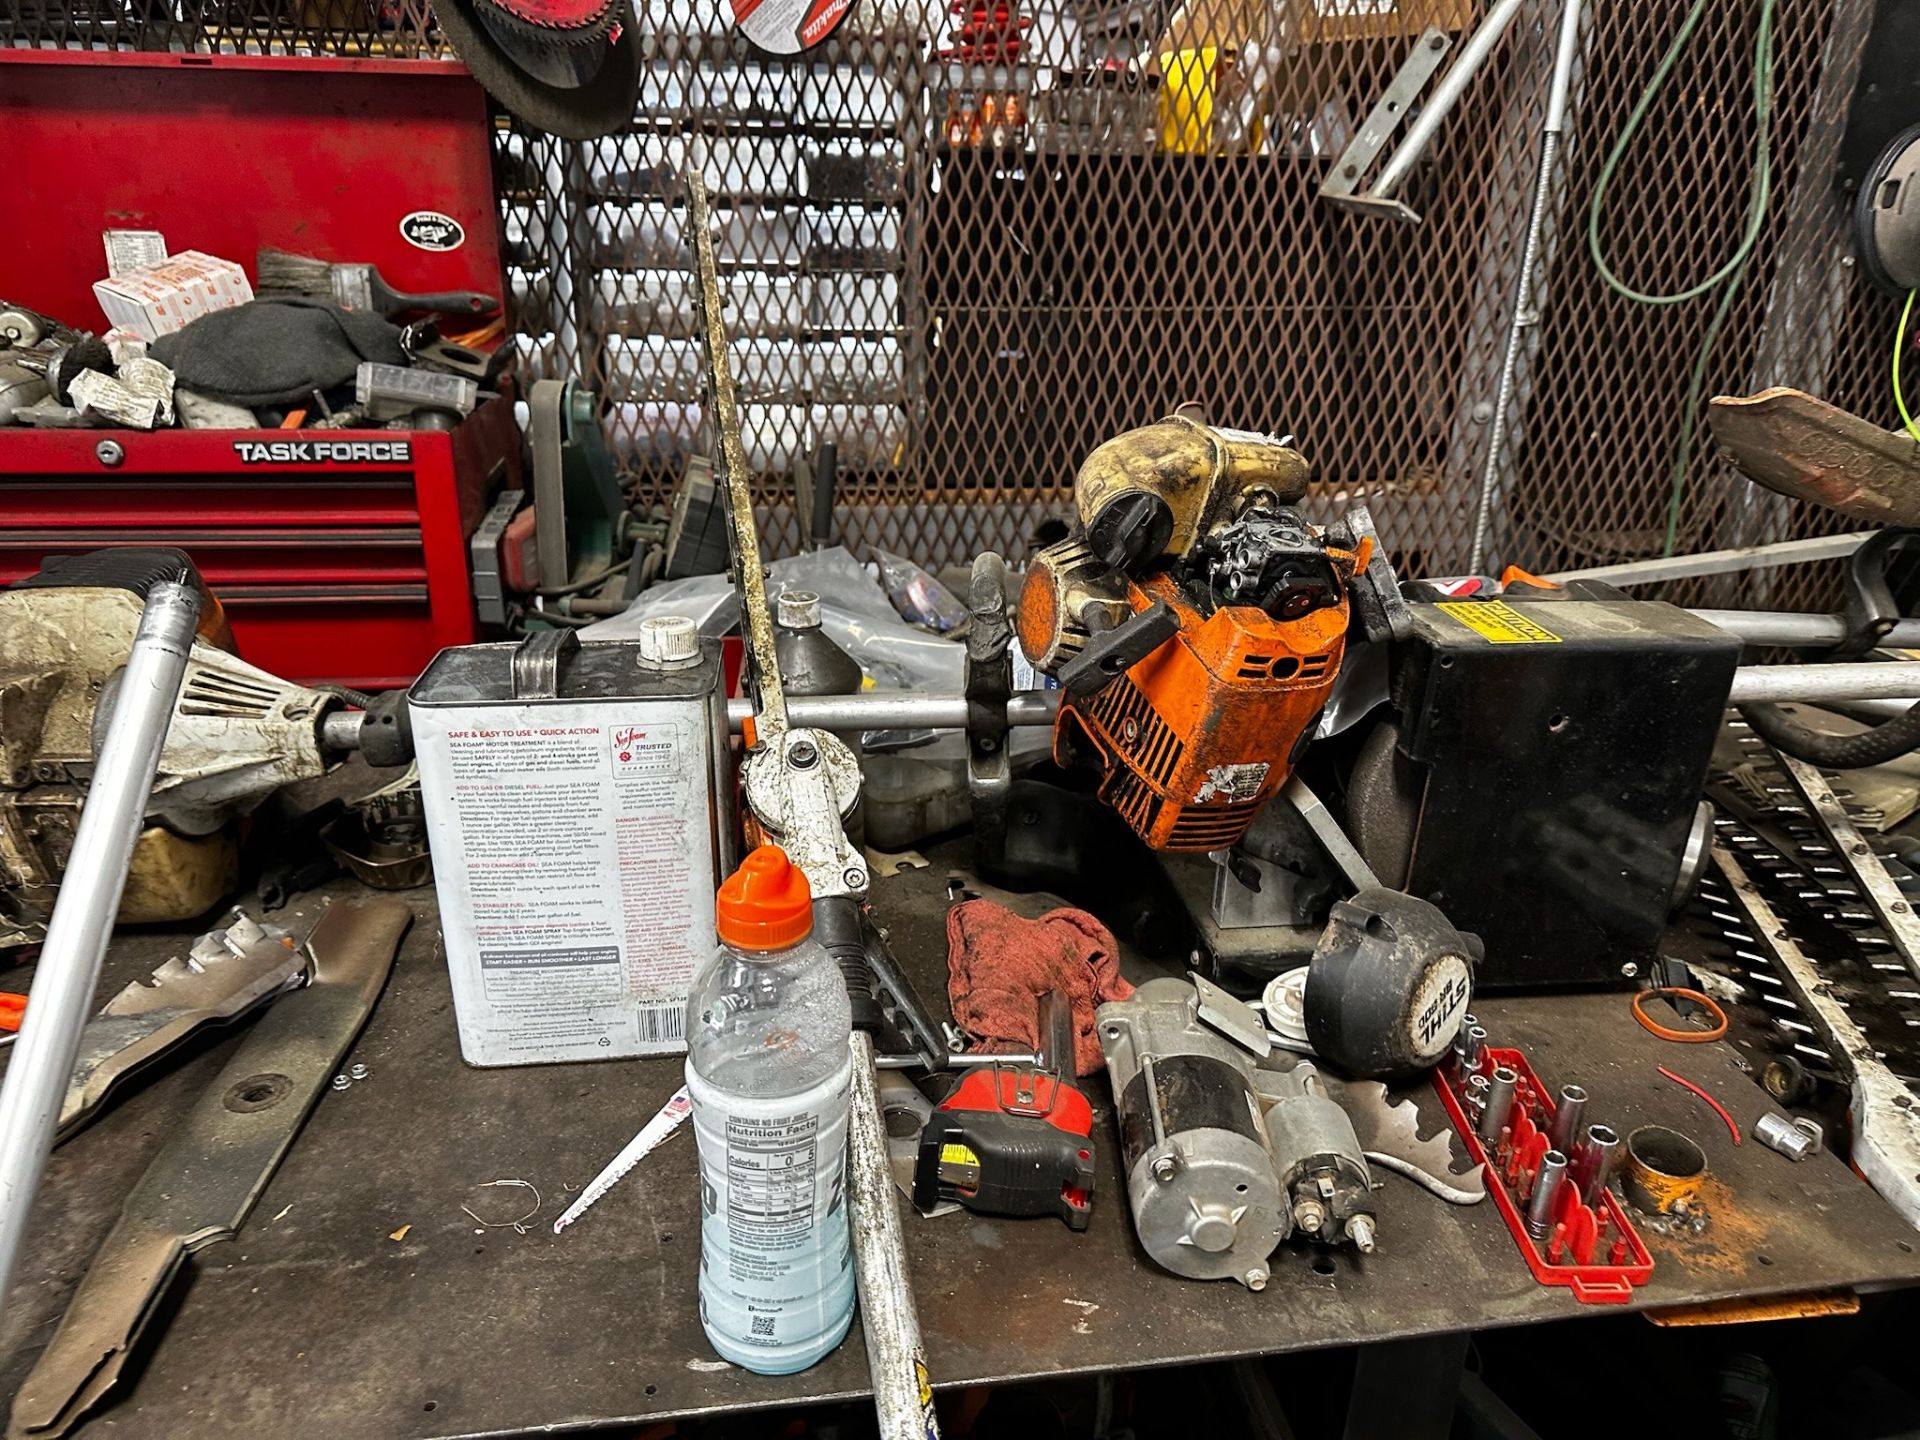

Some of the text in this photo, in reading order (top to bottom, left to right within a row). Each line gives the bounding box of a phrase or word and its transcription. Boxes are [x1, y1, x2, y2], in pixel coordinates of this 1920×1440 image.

[234, 443, 409, 461] TASK FORCE
[1484, 603, 1552, 641] CAUTION
[479, 730, 500, 738] EASY
[539, 728, 566, 736] QUICK
[567, 727, 598, 735] ACTION
[615, 728, 647, 750] Sea Foam
[1418, 978, 1452, 1029] BR 600
[1419, 976, 1466, 1045] STIHL
[728, 1120, 816, 1137] Nutrition Facts
[729, 1115, 760, 1126] CONTAINS
[773, 1116, 790, 1126] FRUIT
[792, 1112, 808, 1124] JUICE
[729, 1149, 814, 1168] Calories 0 5
